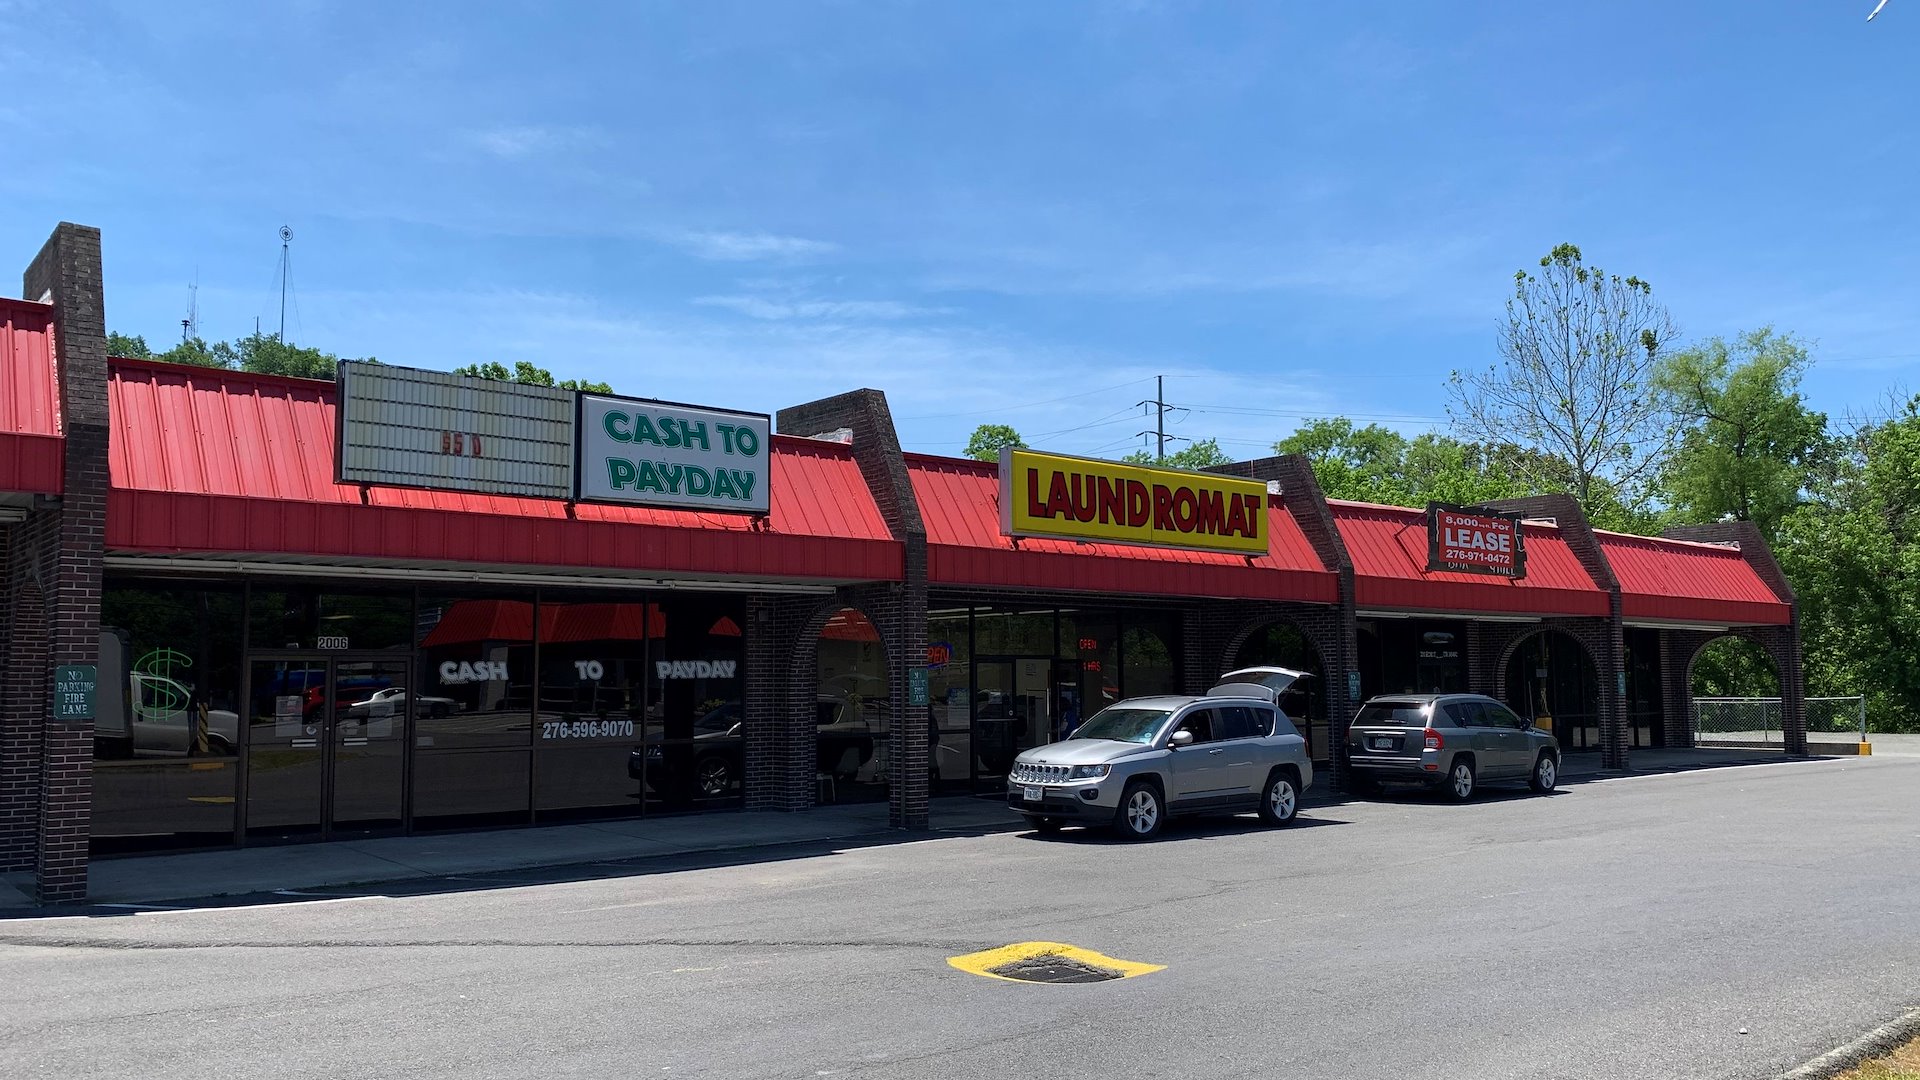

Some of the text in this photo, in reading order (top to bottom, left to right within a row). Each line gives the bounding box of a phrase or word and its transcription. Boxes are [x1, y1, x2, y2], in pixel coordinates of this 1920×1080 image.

[602, 409, 760, 457] CASH TO
[606, 457, 757, 501] PAYDAY
[1027, 467, 1261, 539] LAUNDROMAT
[1445, 516, 1479, 527] 8,000
[1491, 522, 1510, 531] For
[1445, 527, 1511, 553] LEASE
[1446, 549, 1510, 564] 276-971-0472
[318, 637, 348, 649] 2006
[1079, 638, 1097, 649] OPEN
[928, 647, 950, 663] PEN
[68, 670, 84, 681] NO
[439, 660, 737, 682] CASH TO PAYDAY
[57, 681, 95, 692] PARKING
[64, 693, 85, 703] FIRE
[62, 704, 88, 715] LANE
[542, 720, 634, 739] 276-596-9070
